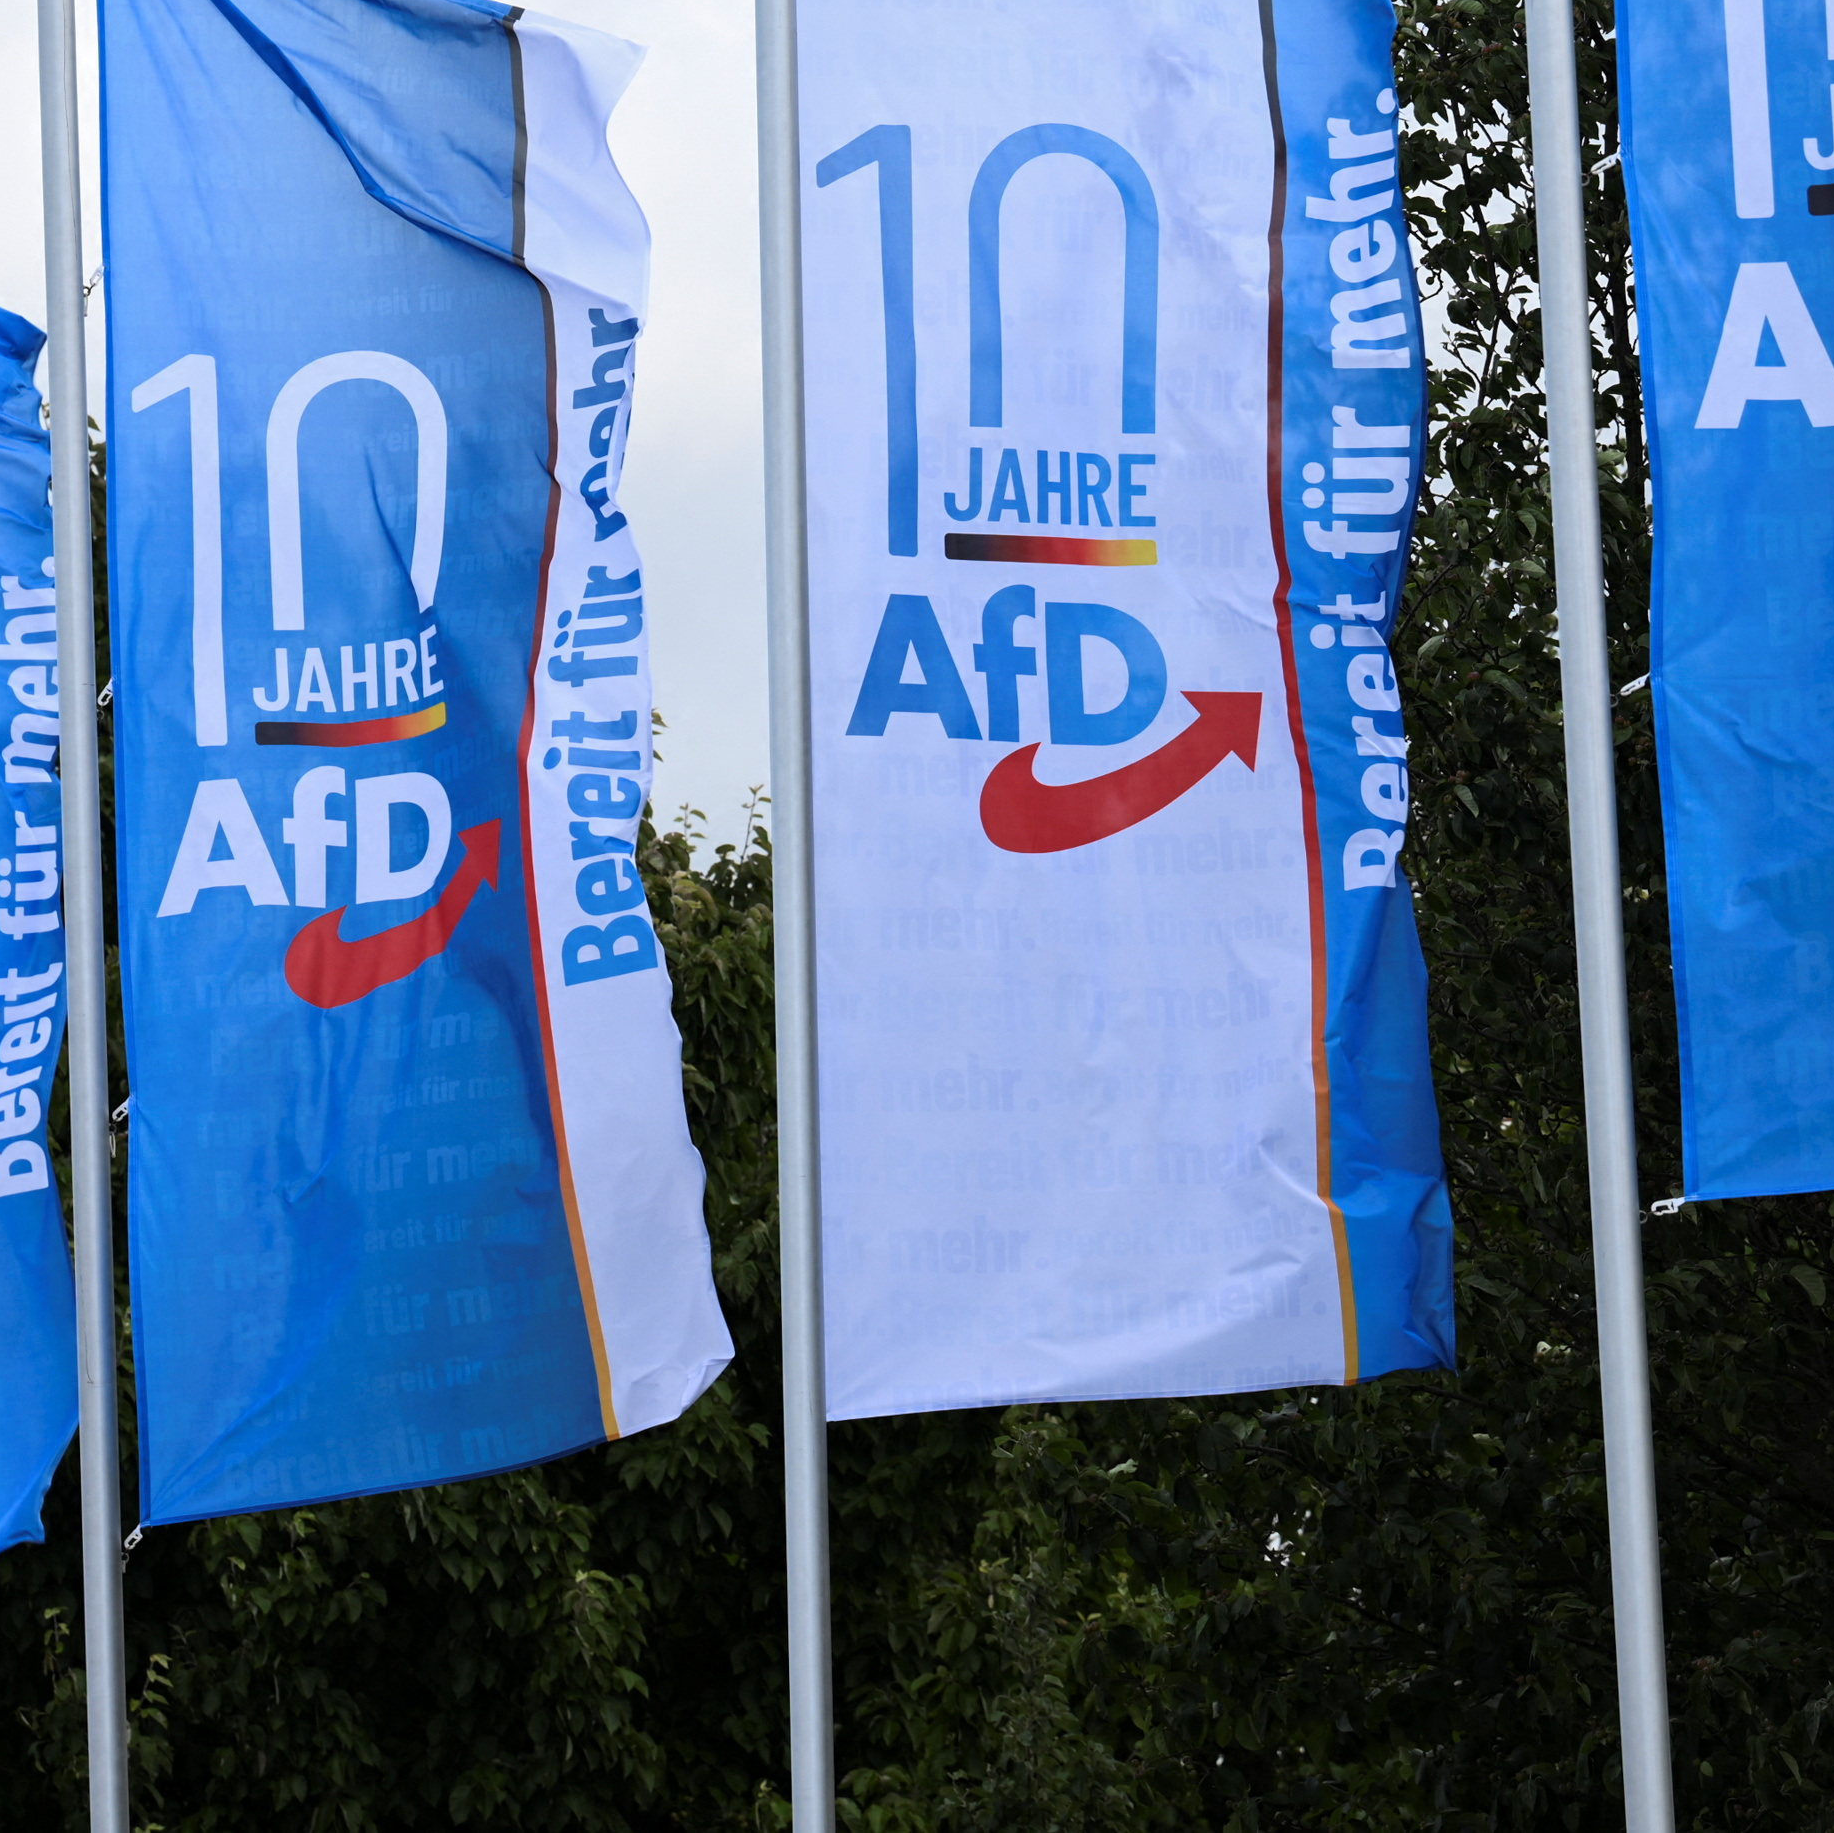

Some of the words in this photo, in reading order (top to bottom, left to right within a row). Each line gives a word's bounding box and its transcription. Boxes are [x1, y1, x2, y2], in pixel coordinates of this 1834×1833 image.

[1305, 85, 1412, 372] mehr.
[944, 447, 1156, 528] JAHRE
[1301, 405, 1412, 560] für
[253, 623, 447, 714] JAHRE
[547, 565, 644, 688] für
[845, 584, 1167, 746] AfD
[1309, 590, 1409, 892] Bereit
[156, 766, 452, 919] AfD
[541, 702, 659, 987] Bereit
